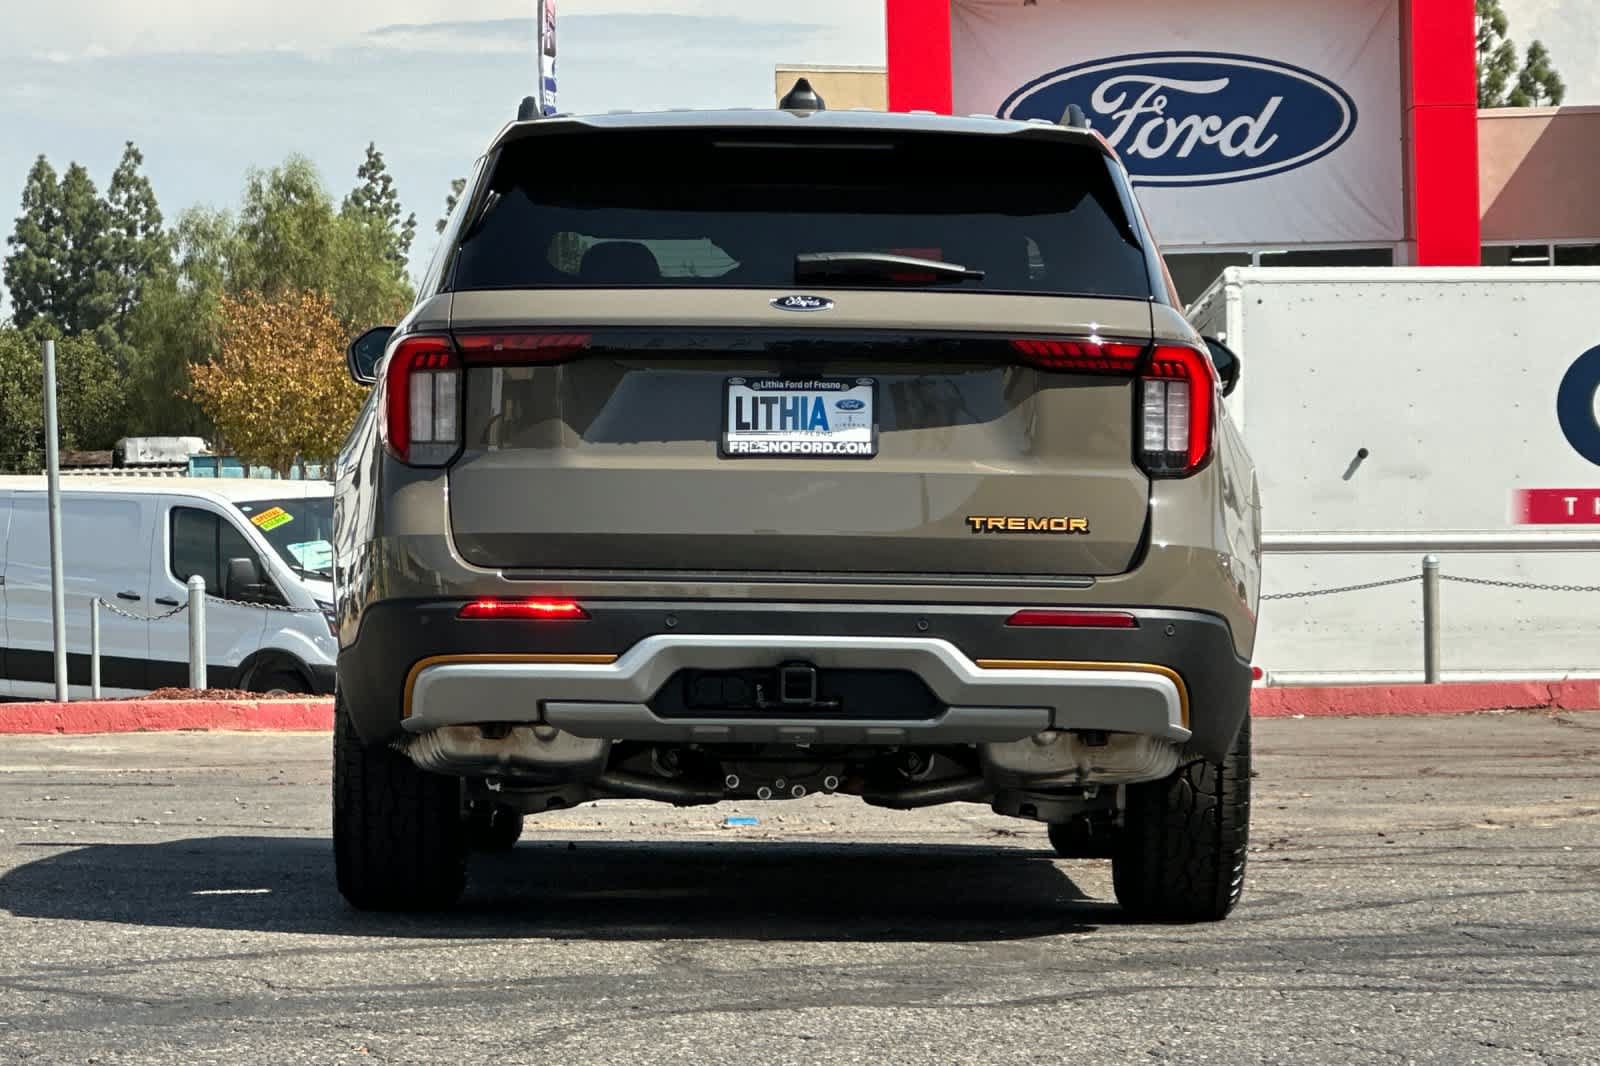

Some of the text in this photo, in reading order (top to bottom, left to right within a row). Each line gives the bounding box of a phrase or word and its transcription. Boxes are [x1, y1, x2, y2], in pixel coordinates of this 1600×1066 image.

[1085, 75, 1283, 158] Ford
[761, 380, 841, 390] Lithia Ford of Fresno
[736, 396, 830, 431] LITHIA
[729, 441, 872, 454] FRESNOFORD.COM
[967, 516, 1090, 533] TREMOR
